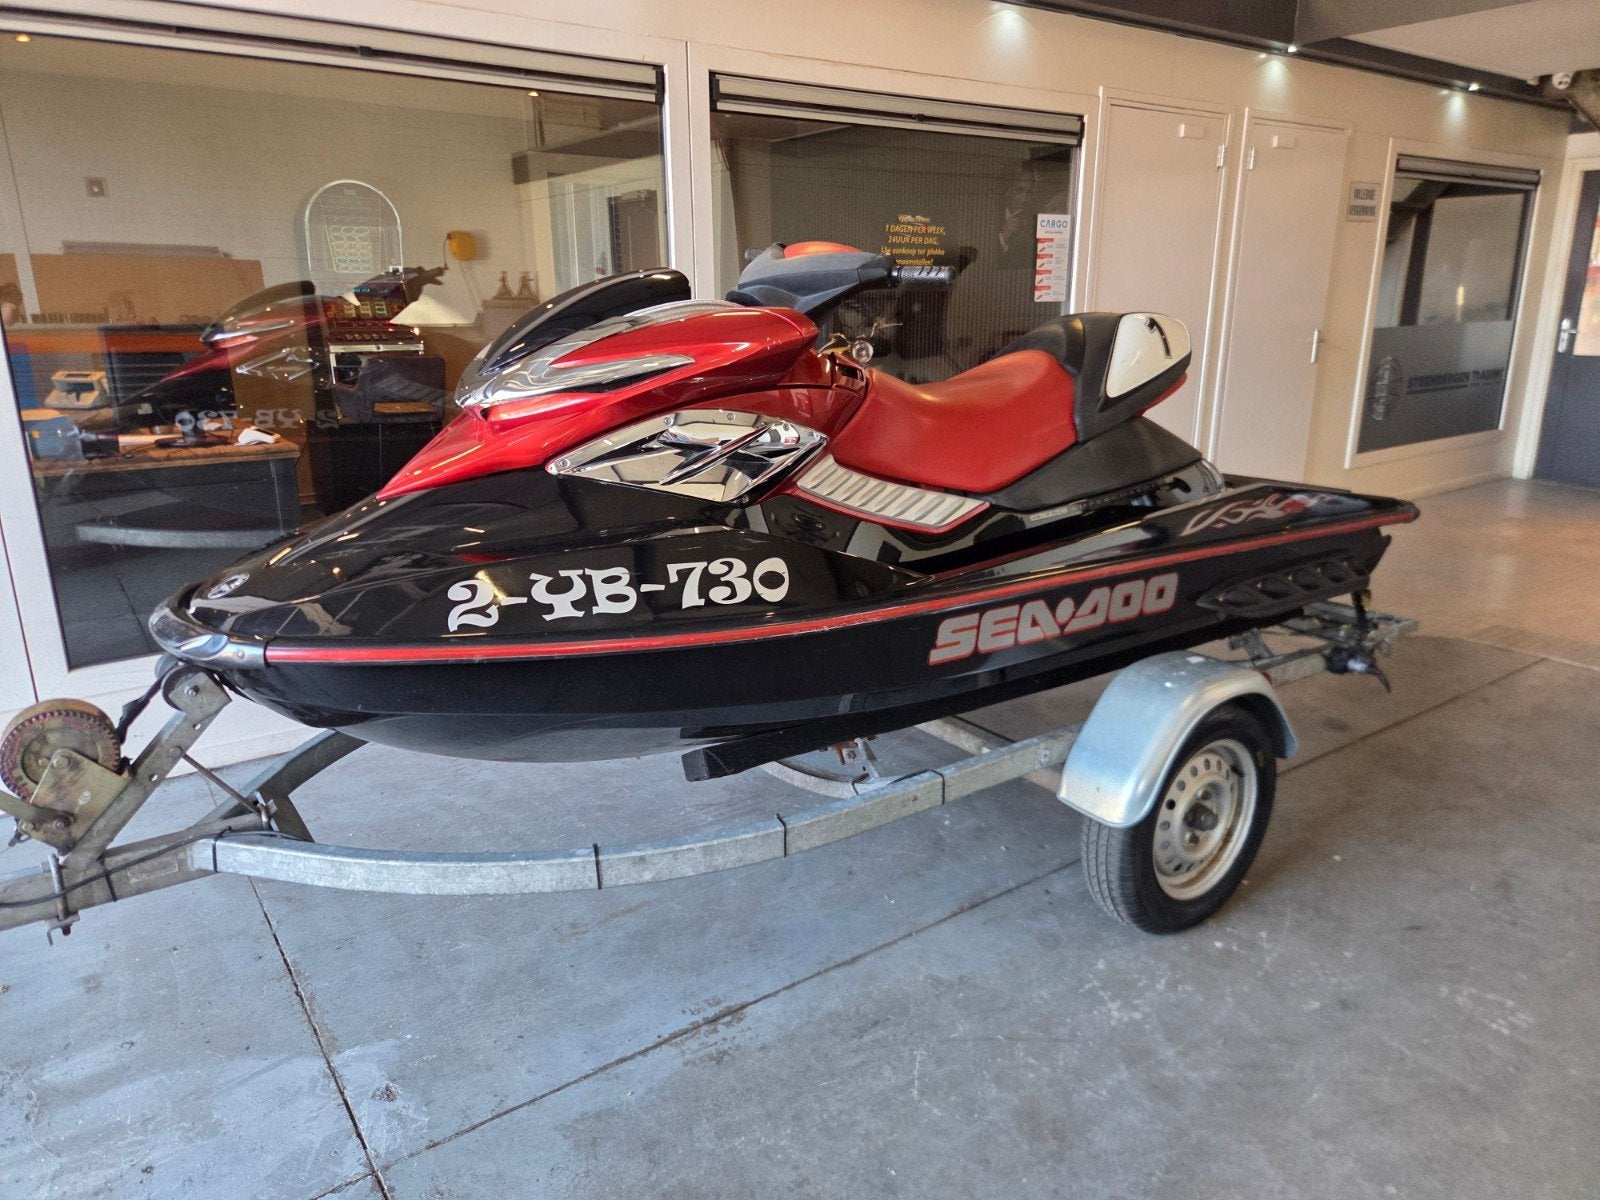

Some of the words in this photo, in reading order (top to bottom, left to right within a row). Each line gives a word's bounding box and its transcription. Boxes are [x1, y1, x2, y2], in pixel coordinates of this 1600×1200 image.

[1040, 219, 1068, 228] CARGO
[914, 225, 926, 234] PER
[911, 236, 923, 244] PER
[447, 557, 790, 632] 2-YB-730
